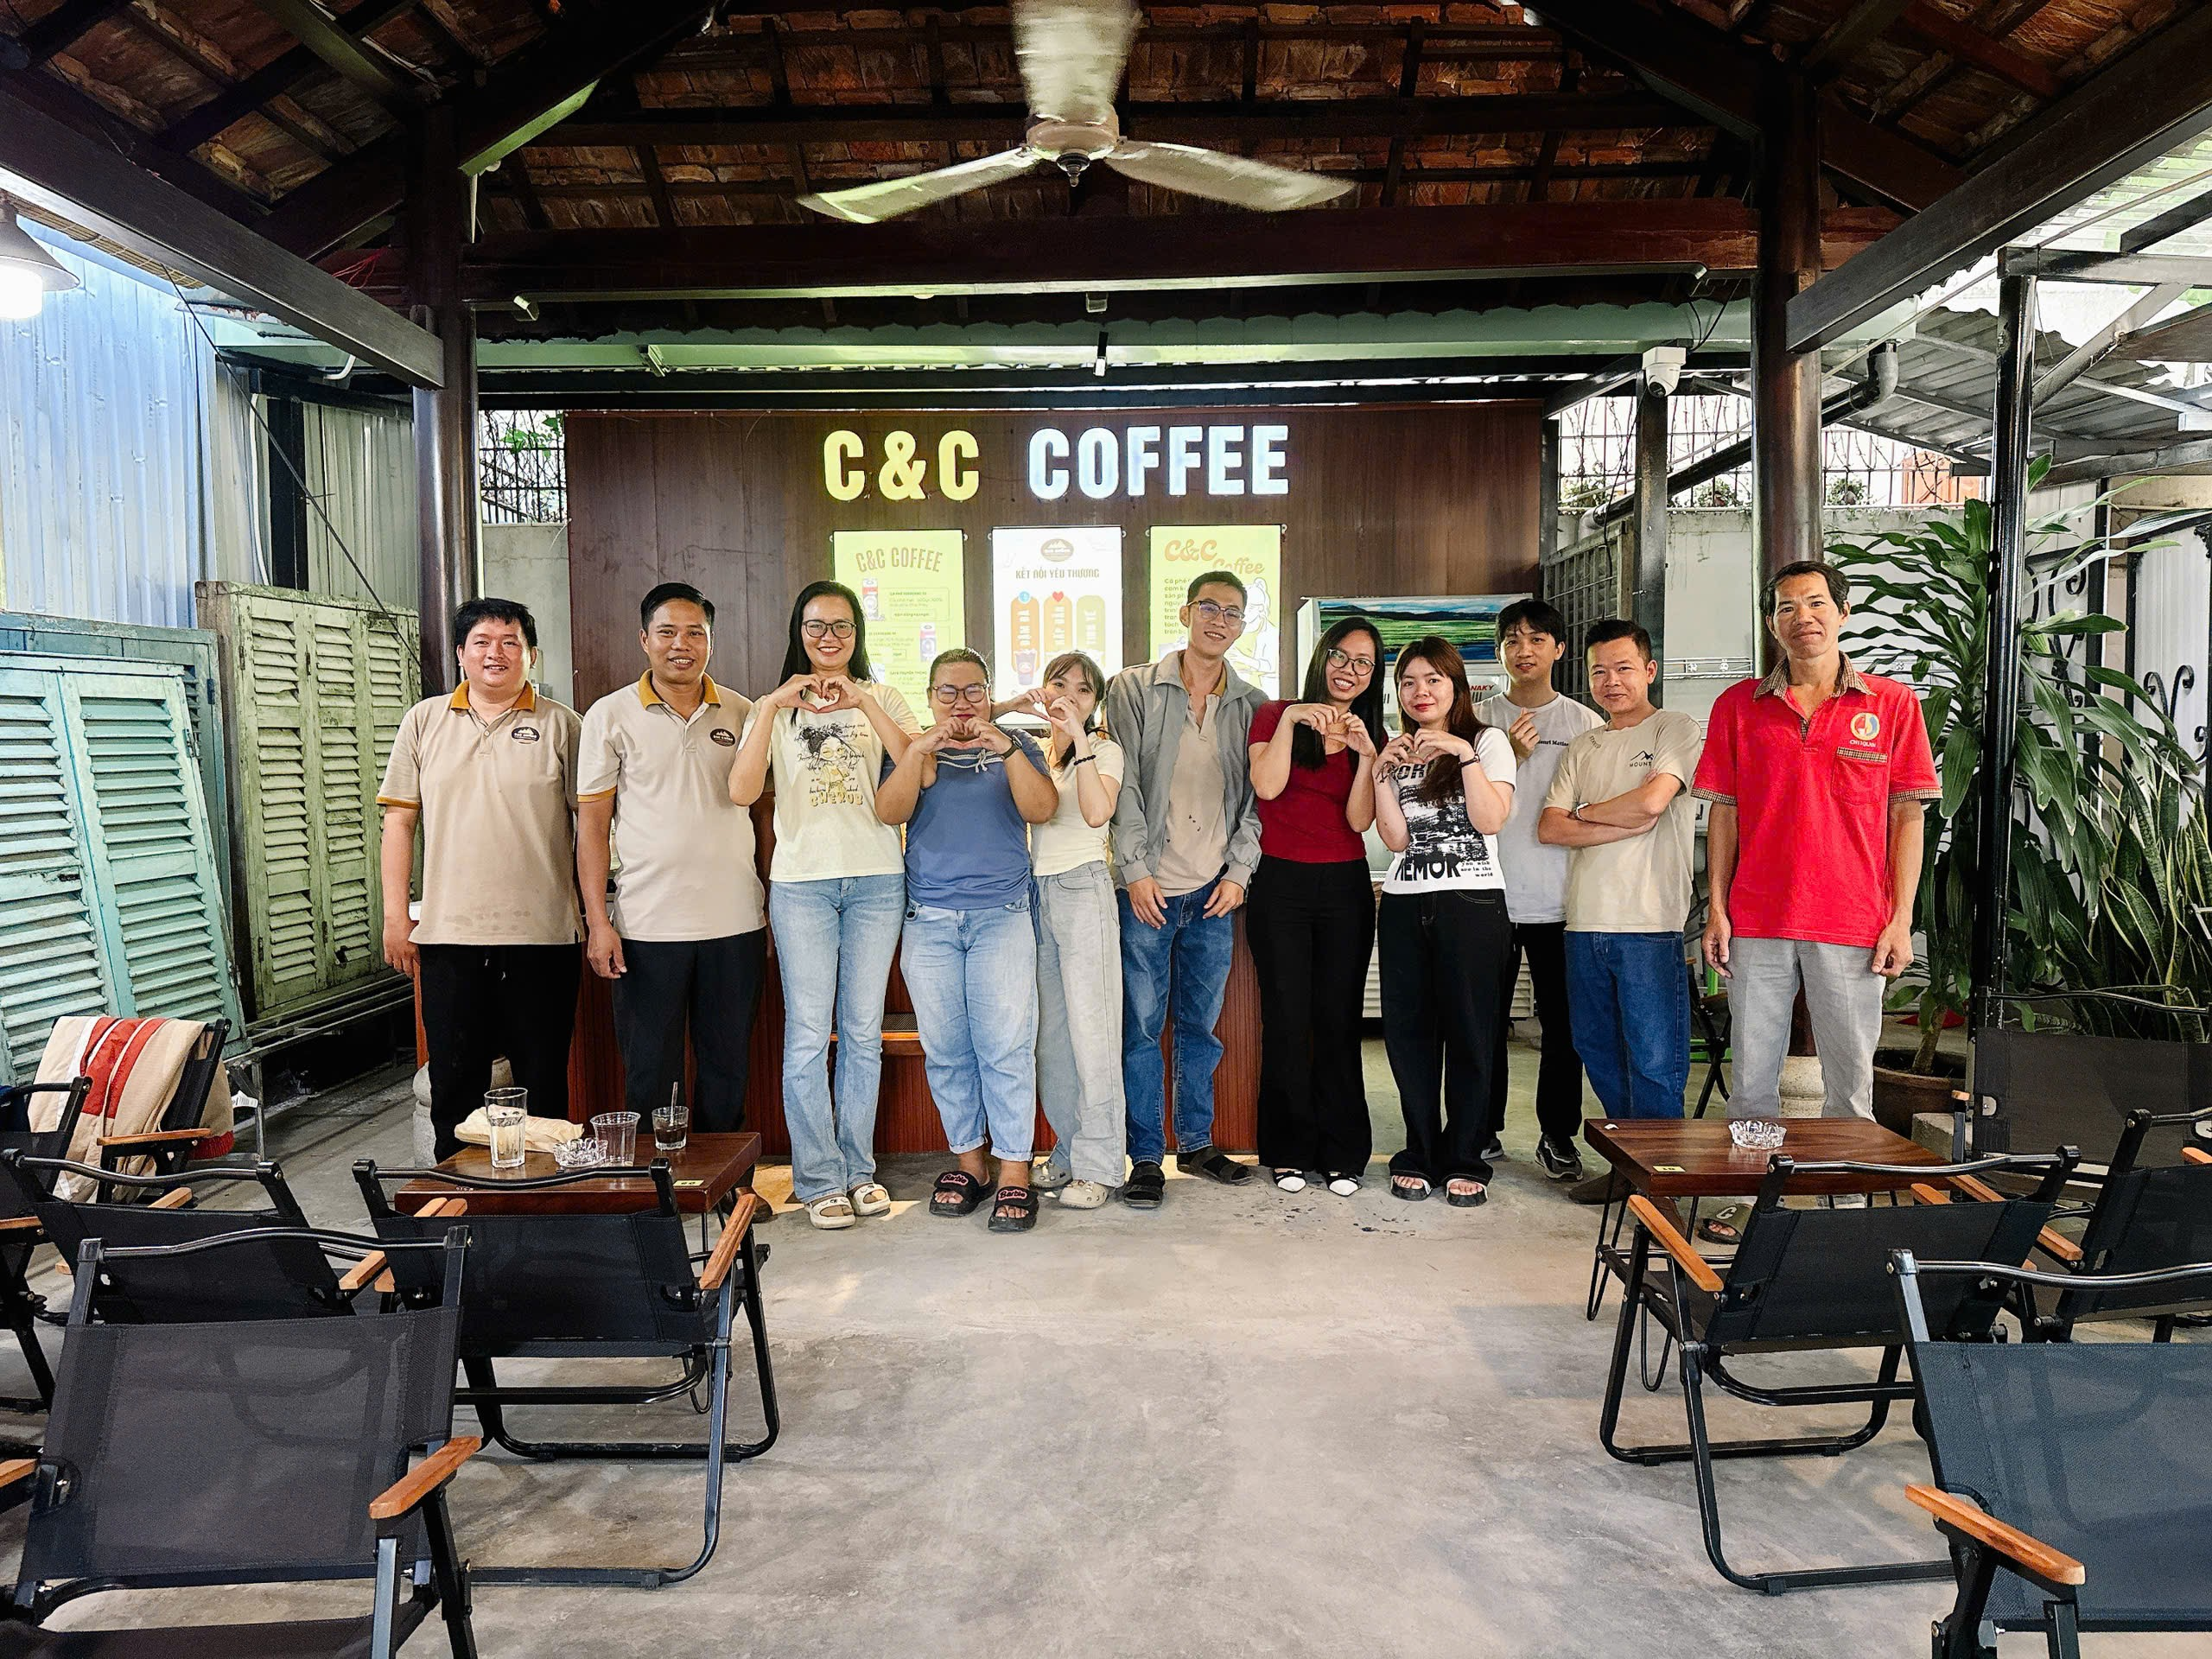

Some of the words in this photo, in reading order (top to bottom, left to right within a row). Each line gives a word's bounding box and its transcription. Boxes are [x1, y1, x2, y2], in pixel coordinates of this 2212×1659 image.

[823, 429, 980, 501] C&C
[1028, 425, 1289, 500] COFFEE
[855, 549, 886, 572] C&C
[891, 547, 943, 573] COFFEE
[1164, 538, 1217, 562] C&C
[942, 1173, 968, 1185] Barbie
[1000, 1190, 1027, 1199] Barbie
